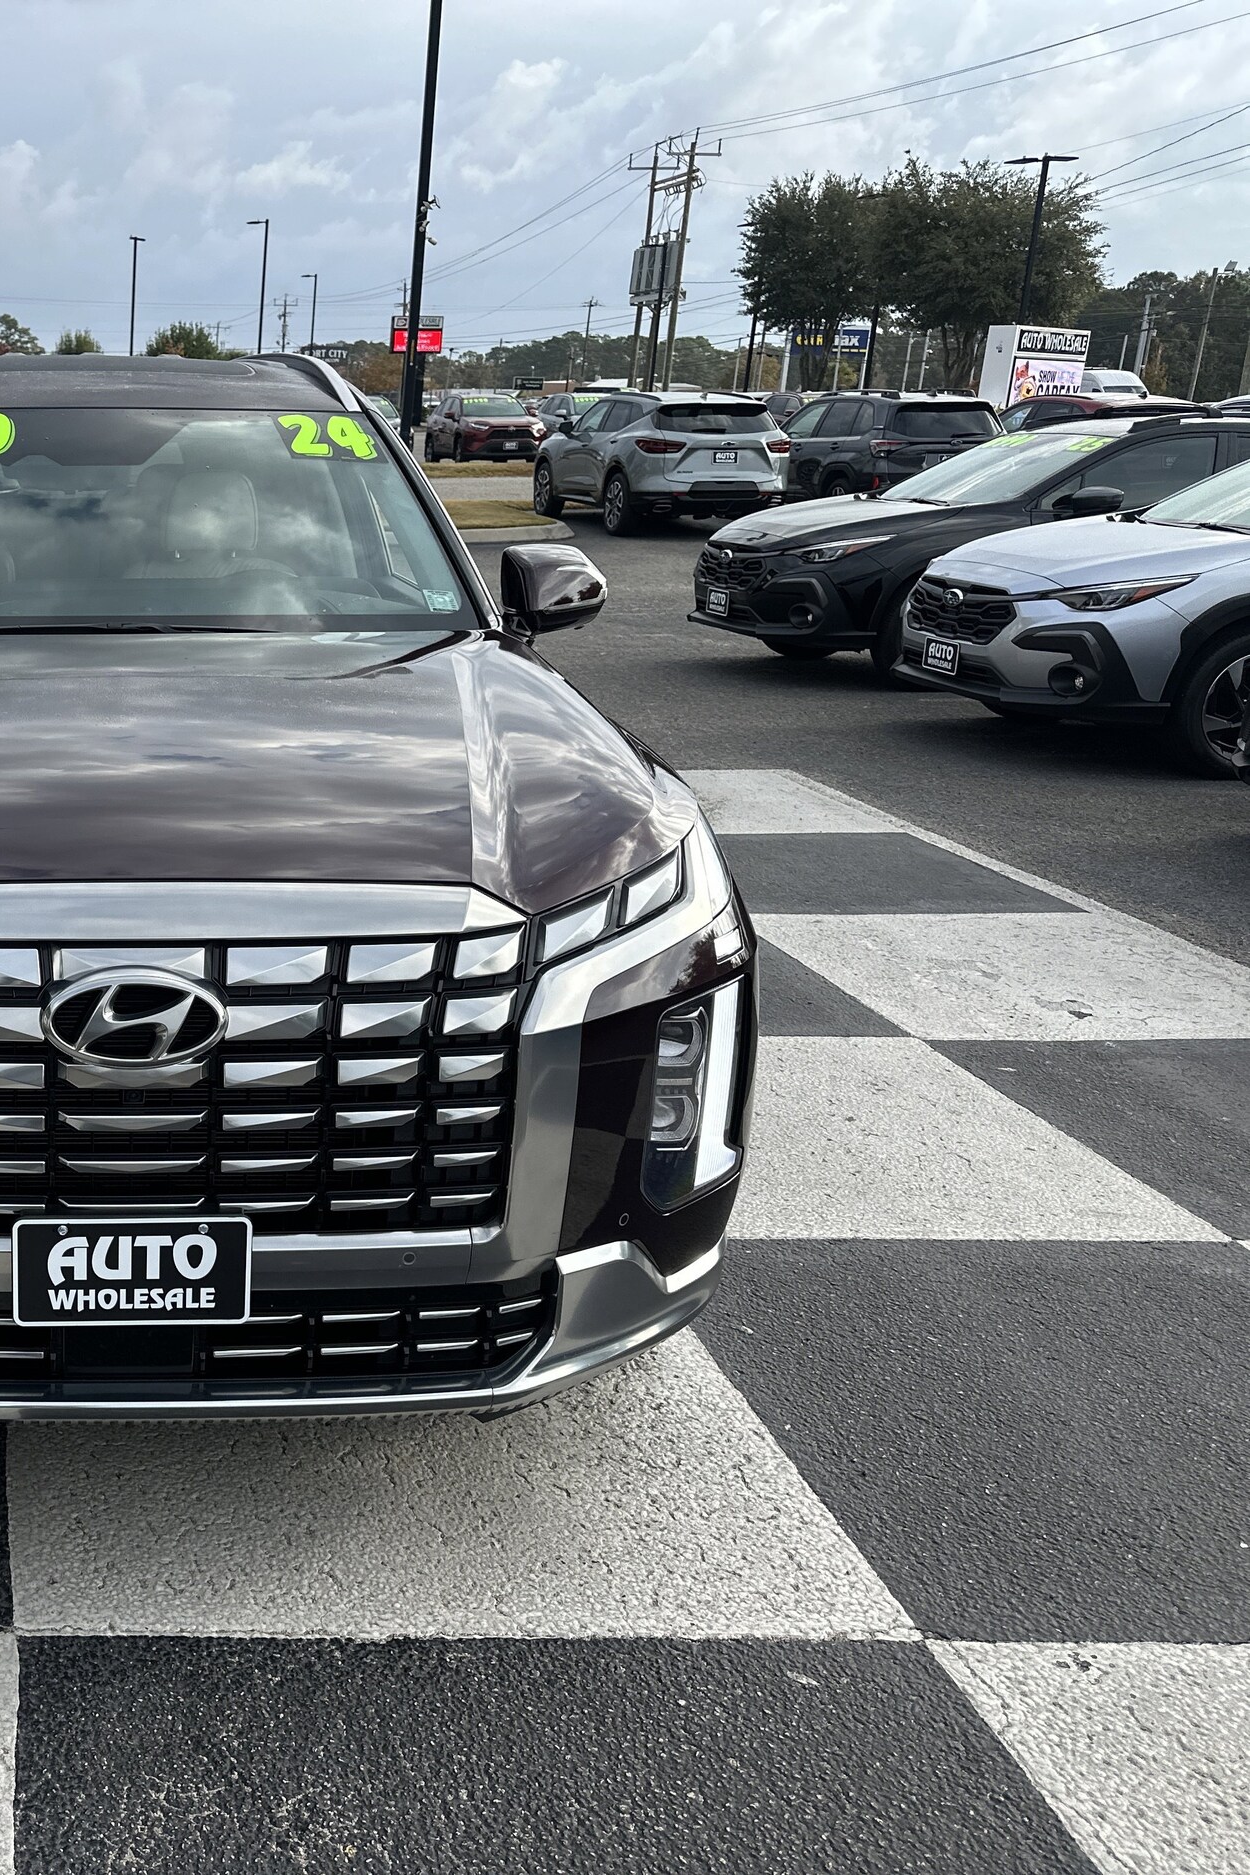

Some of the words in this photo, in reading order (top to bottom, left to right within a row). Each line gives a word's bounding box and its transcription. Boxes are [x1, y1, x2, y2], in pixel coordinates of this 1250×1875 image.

[1021, 332, 1044, 350] AUTO
[1044, 333, 1087, 352] WHOLESALE
[328, 349, 348, 358] CITY
[1038, 370, 1057, 383] SHOW
[277, 414, 378, 460] 24
[928, 642, 954, 660] AUTO
[47, 1234, 217, 1286] AUTO
[47, 1287, 216, 1312] WHOLESALE
